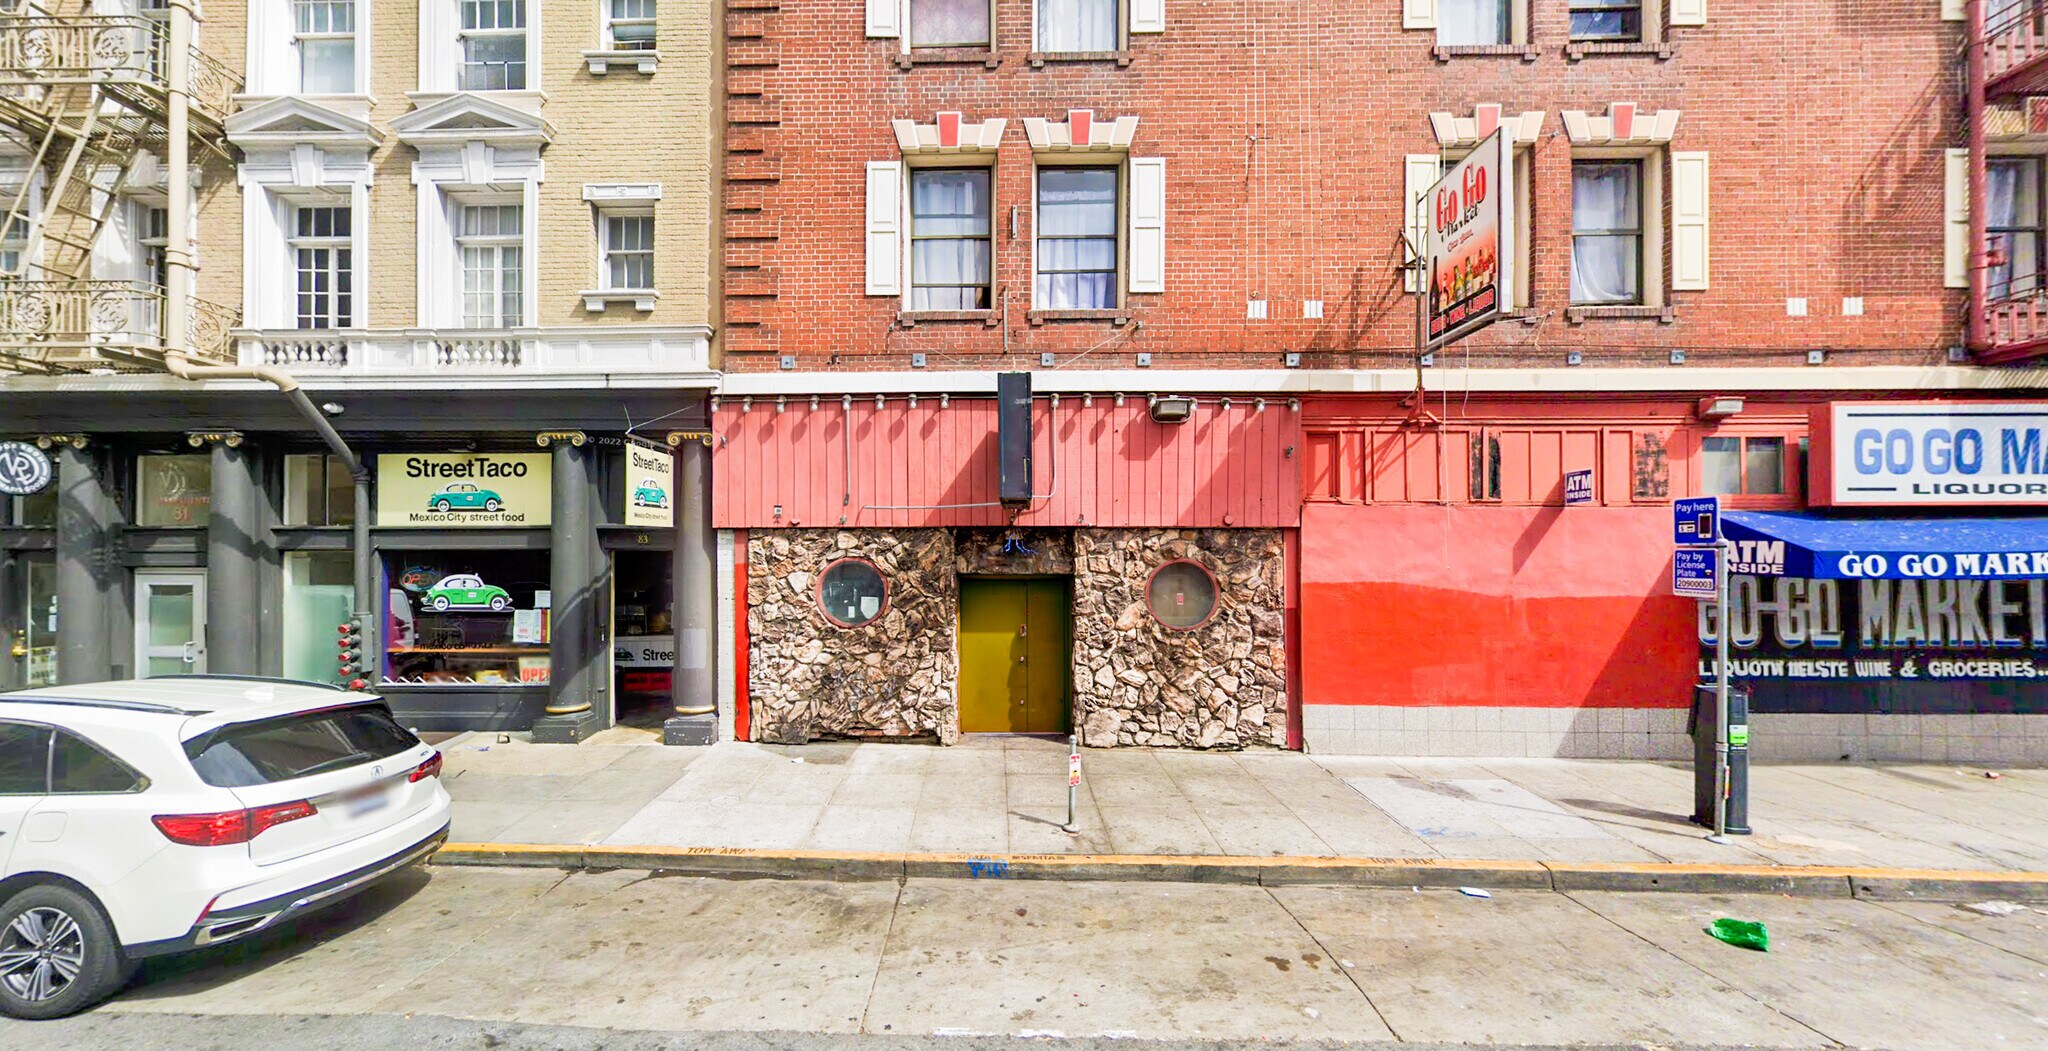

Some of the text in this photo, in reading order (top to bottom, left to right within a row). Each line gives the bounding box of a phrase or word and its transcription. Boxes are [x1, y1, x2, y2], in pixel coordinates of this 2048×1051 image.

[1854, 428, 1914, 475] GO
[1922, 428, 1983, 475] GO
[1567, 474, 1591, 491] ATM
[1566, 490, 1591, 499] INSIDE
[1676, 502, 1714, 514] Pay here
[409, 513, 525, 524] Mexico City street food
[638, 535, 648, 543] 83
[1676, 552, 1704, 561] Pay by
[1676, 561, 1706, 569] License
[1839, 554, 1888, 577] GO
[1898, 554, 1948, 577] GO
[1676, 569, 1697, 578] Plate
[1676, 579, 1713, 589] 20900003
[1855, 660, 1891, 677] WINE
[1900, 661, 1918, 677] &
[720, 847, 756, 855] AWAY
